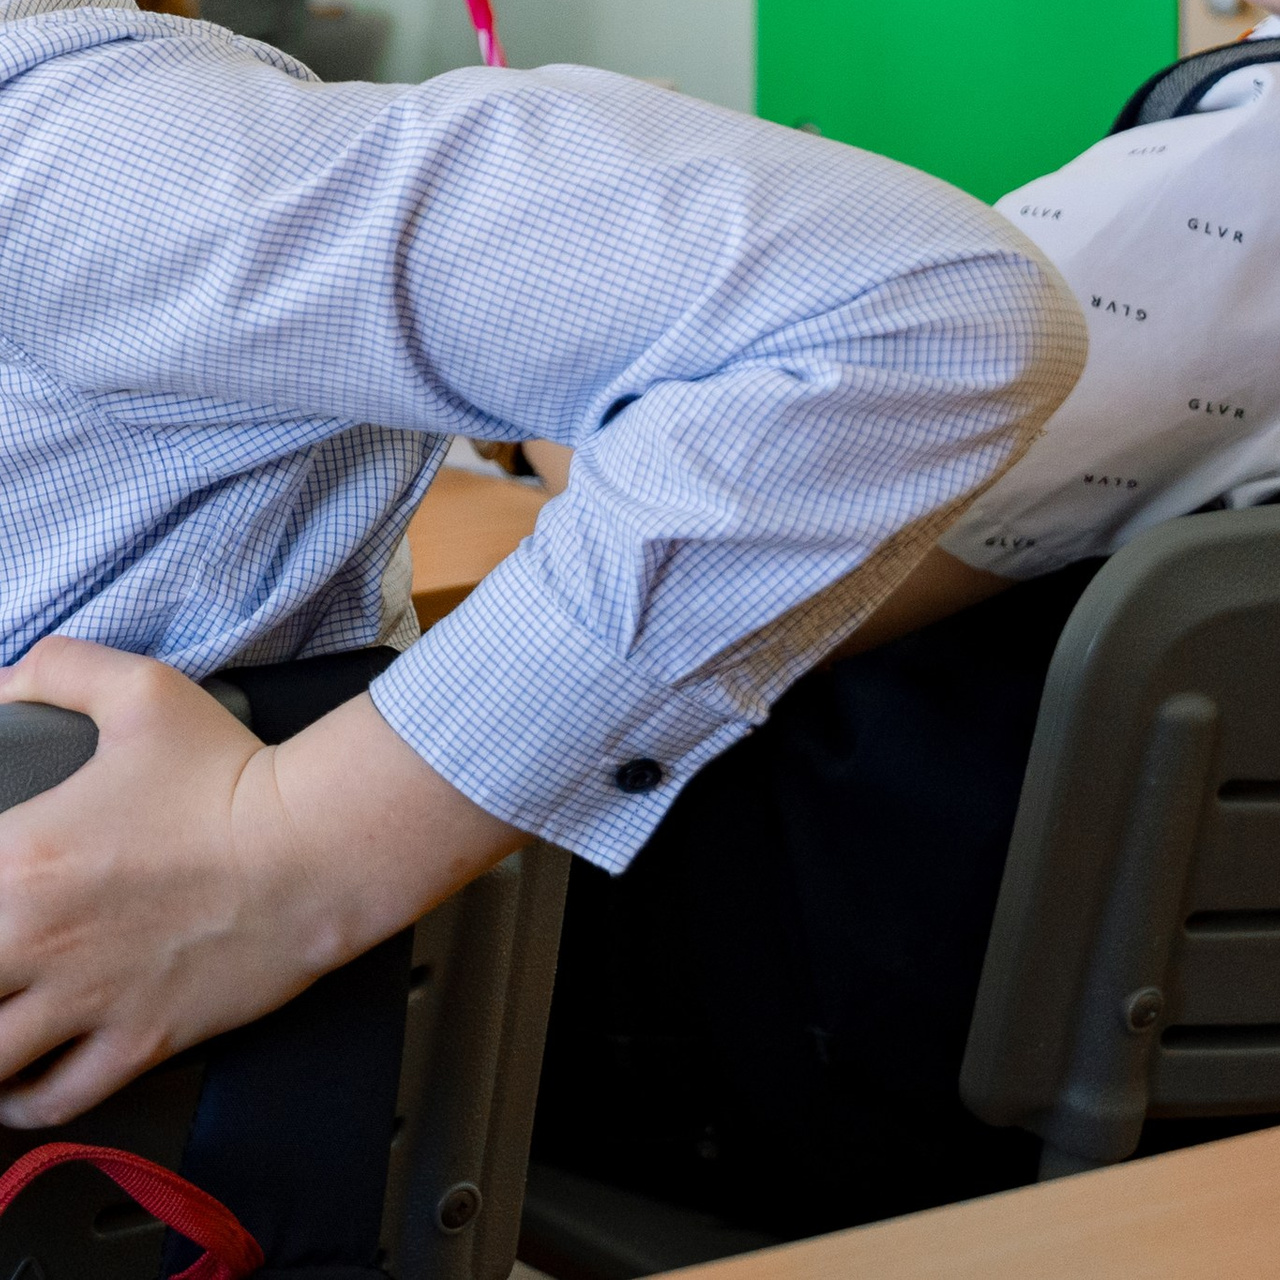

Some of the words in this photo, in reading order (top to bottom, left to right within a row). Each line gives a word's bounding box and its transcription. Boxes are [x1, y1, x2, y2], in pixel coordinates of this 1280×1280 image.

[1020, 205, 1063, 220] GLVR
[1187, 217, 1245, 244] GLVR
[1090, 295, 1148, 322] GLVR
[1187, 398, 1246, 420] GLVR
[1082, 474, 1138, 489] GLVR
